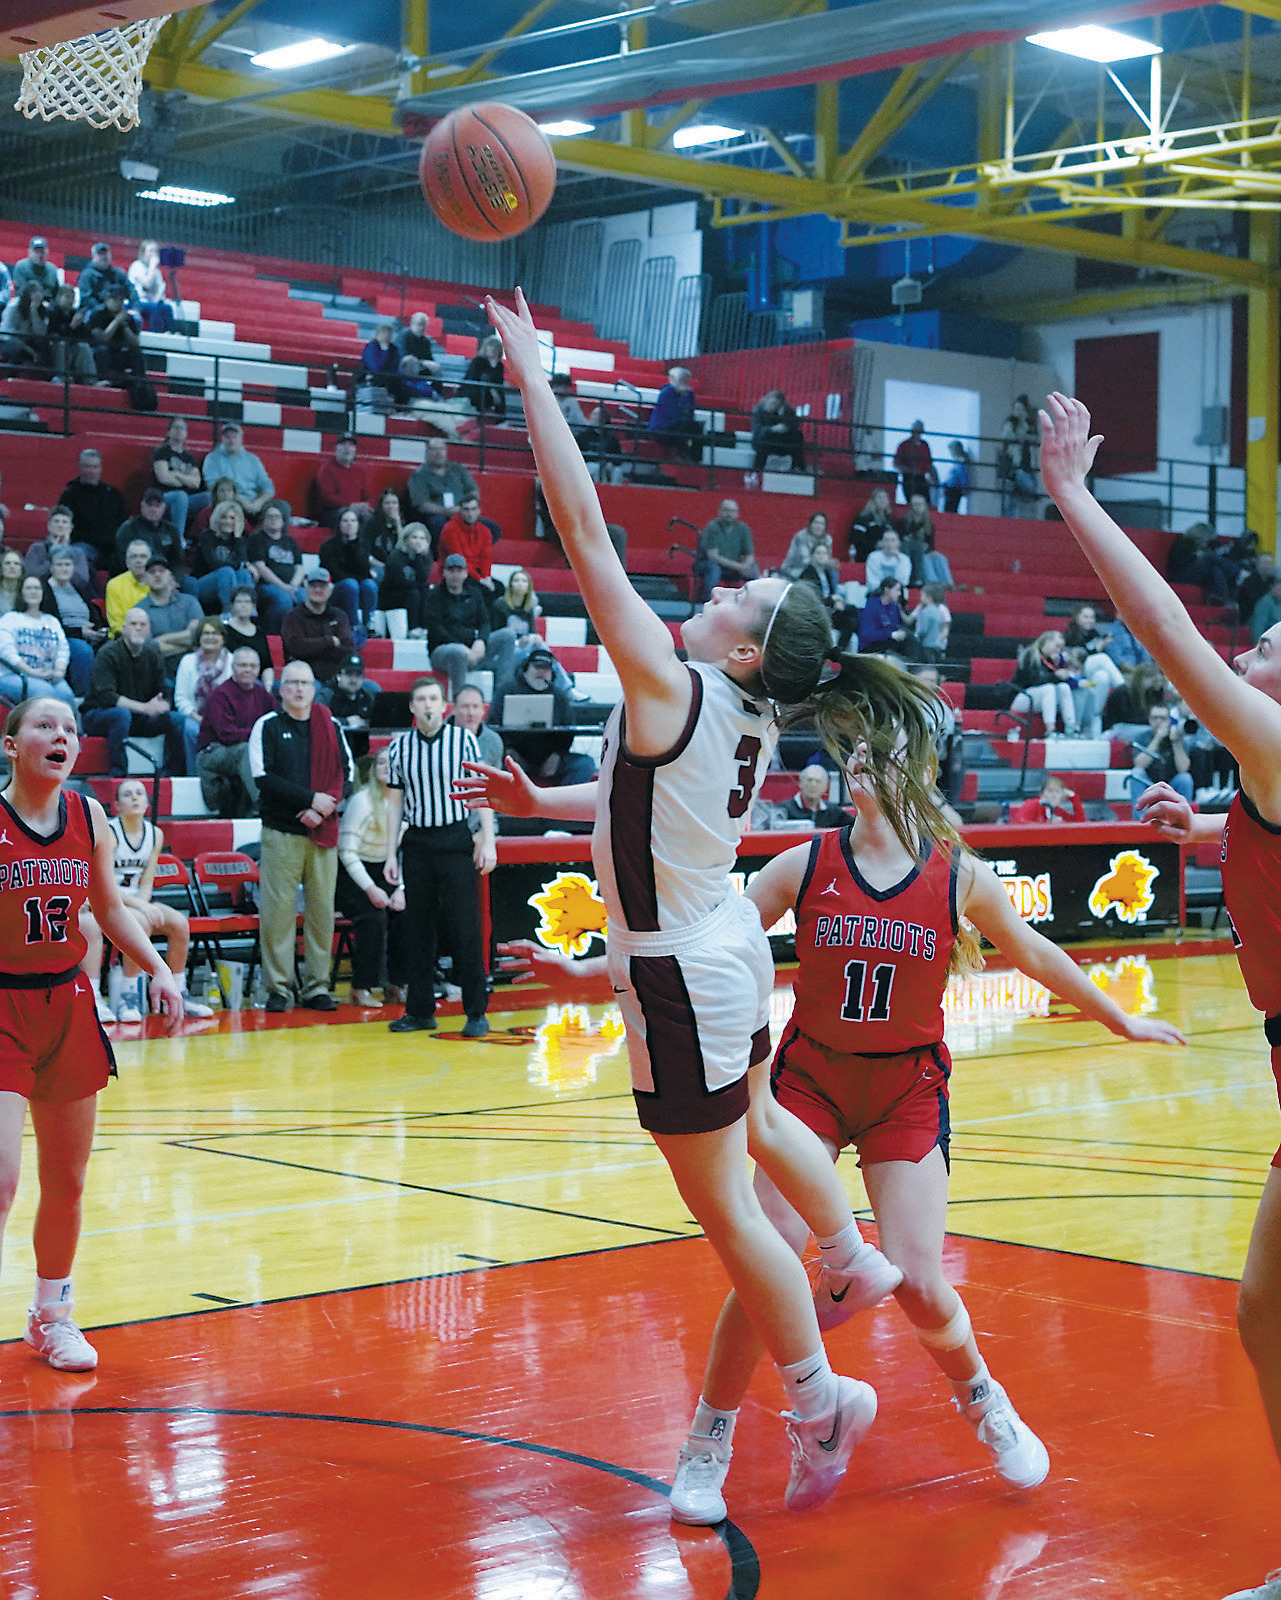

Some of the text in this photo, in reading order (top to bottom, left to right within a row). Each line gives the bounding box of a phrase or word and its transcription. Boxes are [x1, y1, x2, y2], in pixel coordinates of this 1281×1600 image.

[727, 734, 762, 819] 3
[0, 858, 89, 892] PATRIOTS
[24, 895, 73, 945] 12
[814, 914, 937, 961] PATRIOTS
[840, 959, 897, 1022] 11
